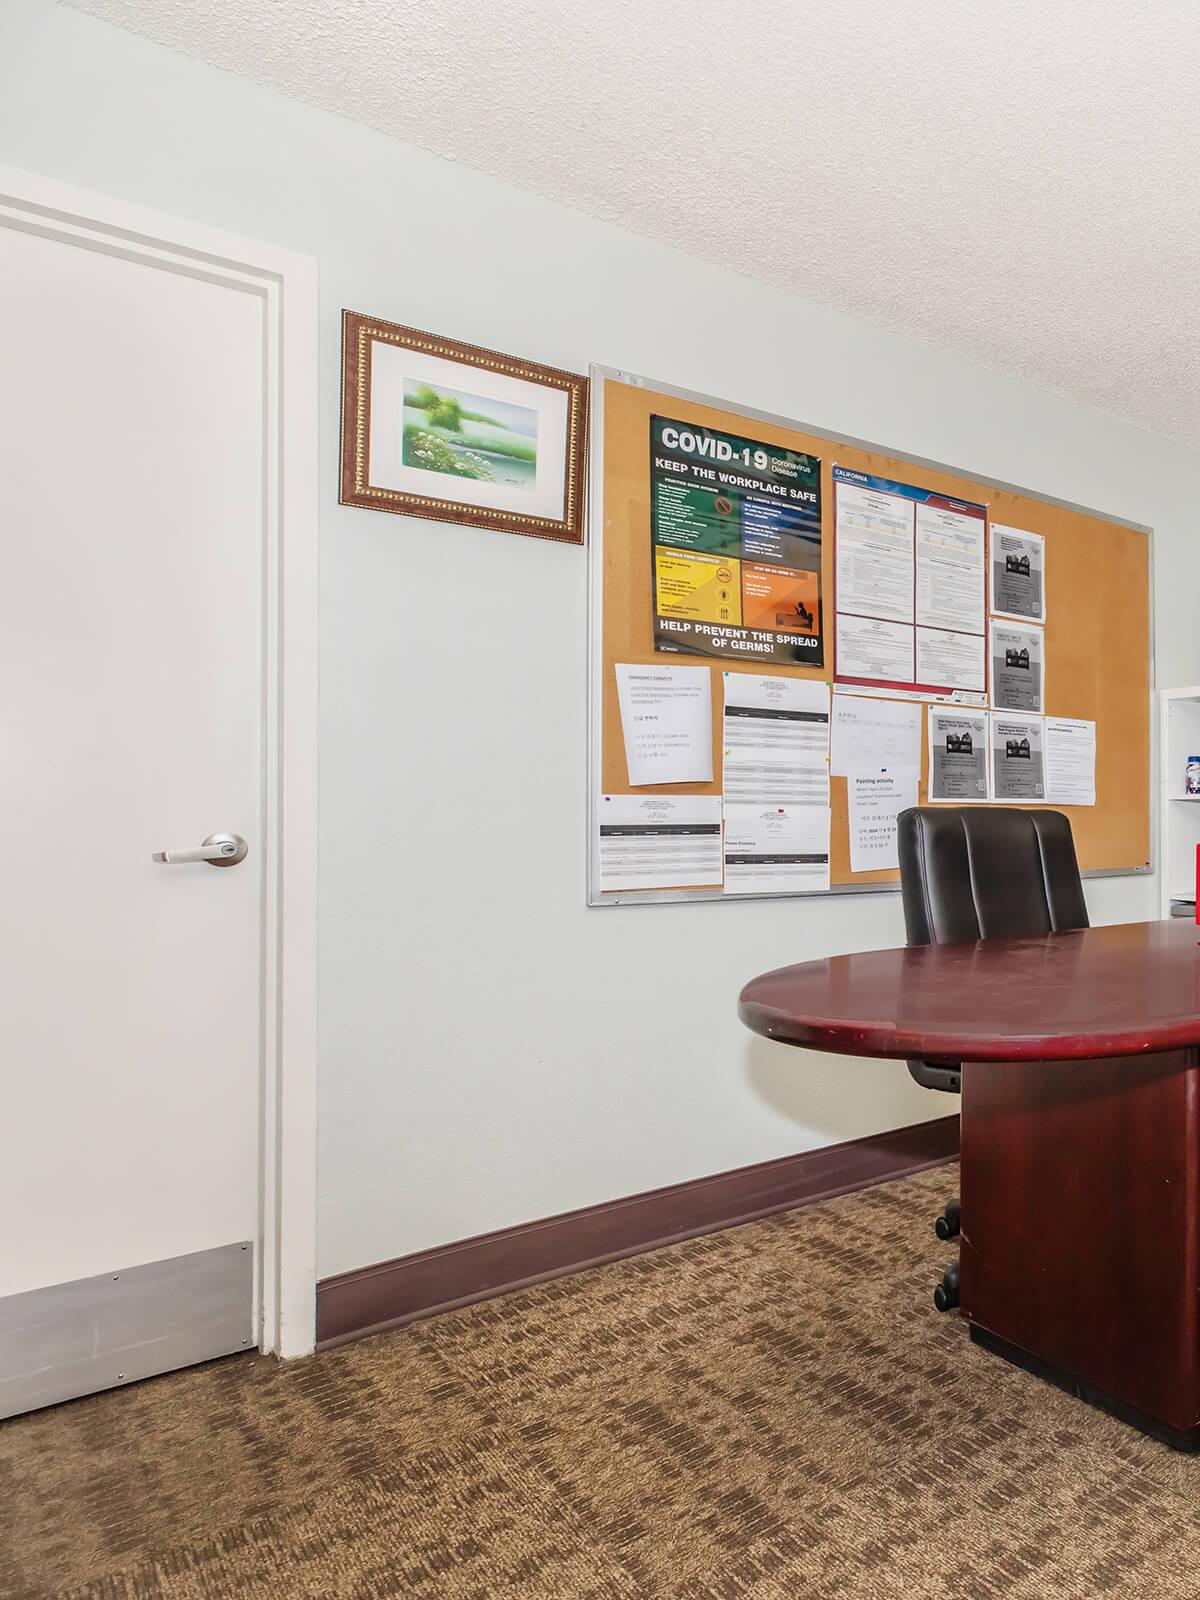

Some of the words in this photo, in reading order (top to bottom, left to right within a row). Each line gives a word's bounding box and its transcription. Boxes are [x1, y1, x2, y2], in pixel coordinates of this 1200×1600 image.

[661, 427, 768, 470] COVID-19
[771, 457, 812, 474] Coronavirus
[771, 465, 799, 478] Disease
[655, 457, 689, 474] KEEP
[691, 466, 716, 480] THE
[718, 472, 787, 497] WORKPLACE
[790, 488, 818, 503] SAFE
[834, 468, 868, 482] CALIFORNIA
[660, 619, 692, 633] HELP
[694, 624, 748, 640] PREVENT
[751, 631, 774, 642] THE
[776, 635, 819, 648] SPREAD
[711, 637, 728, 648] OF
[730, 640, 775, 654] GERMS!
